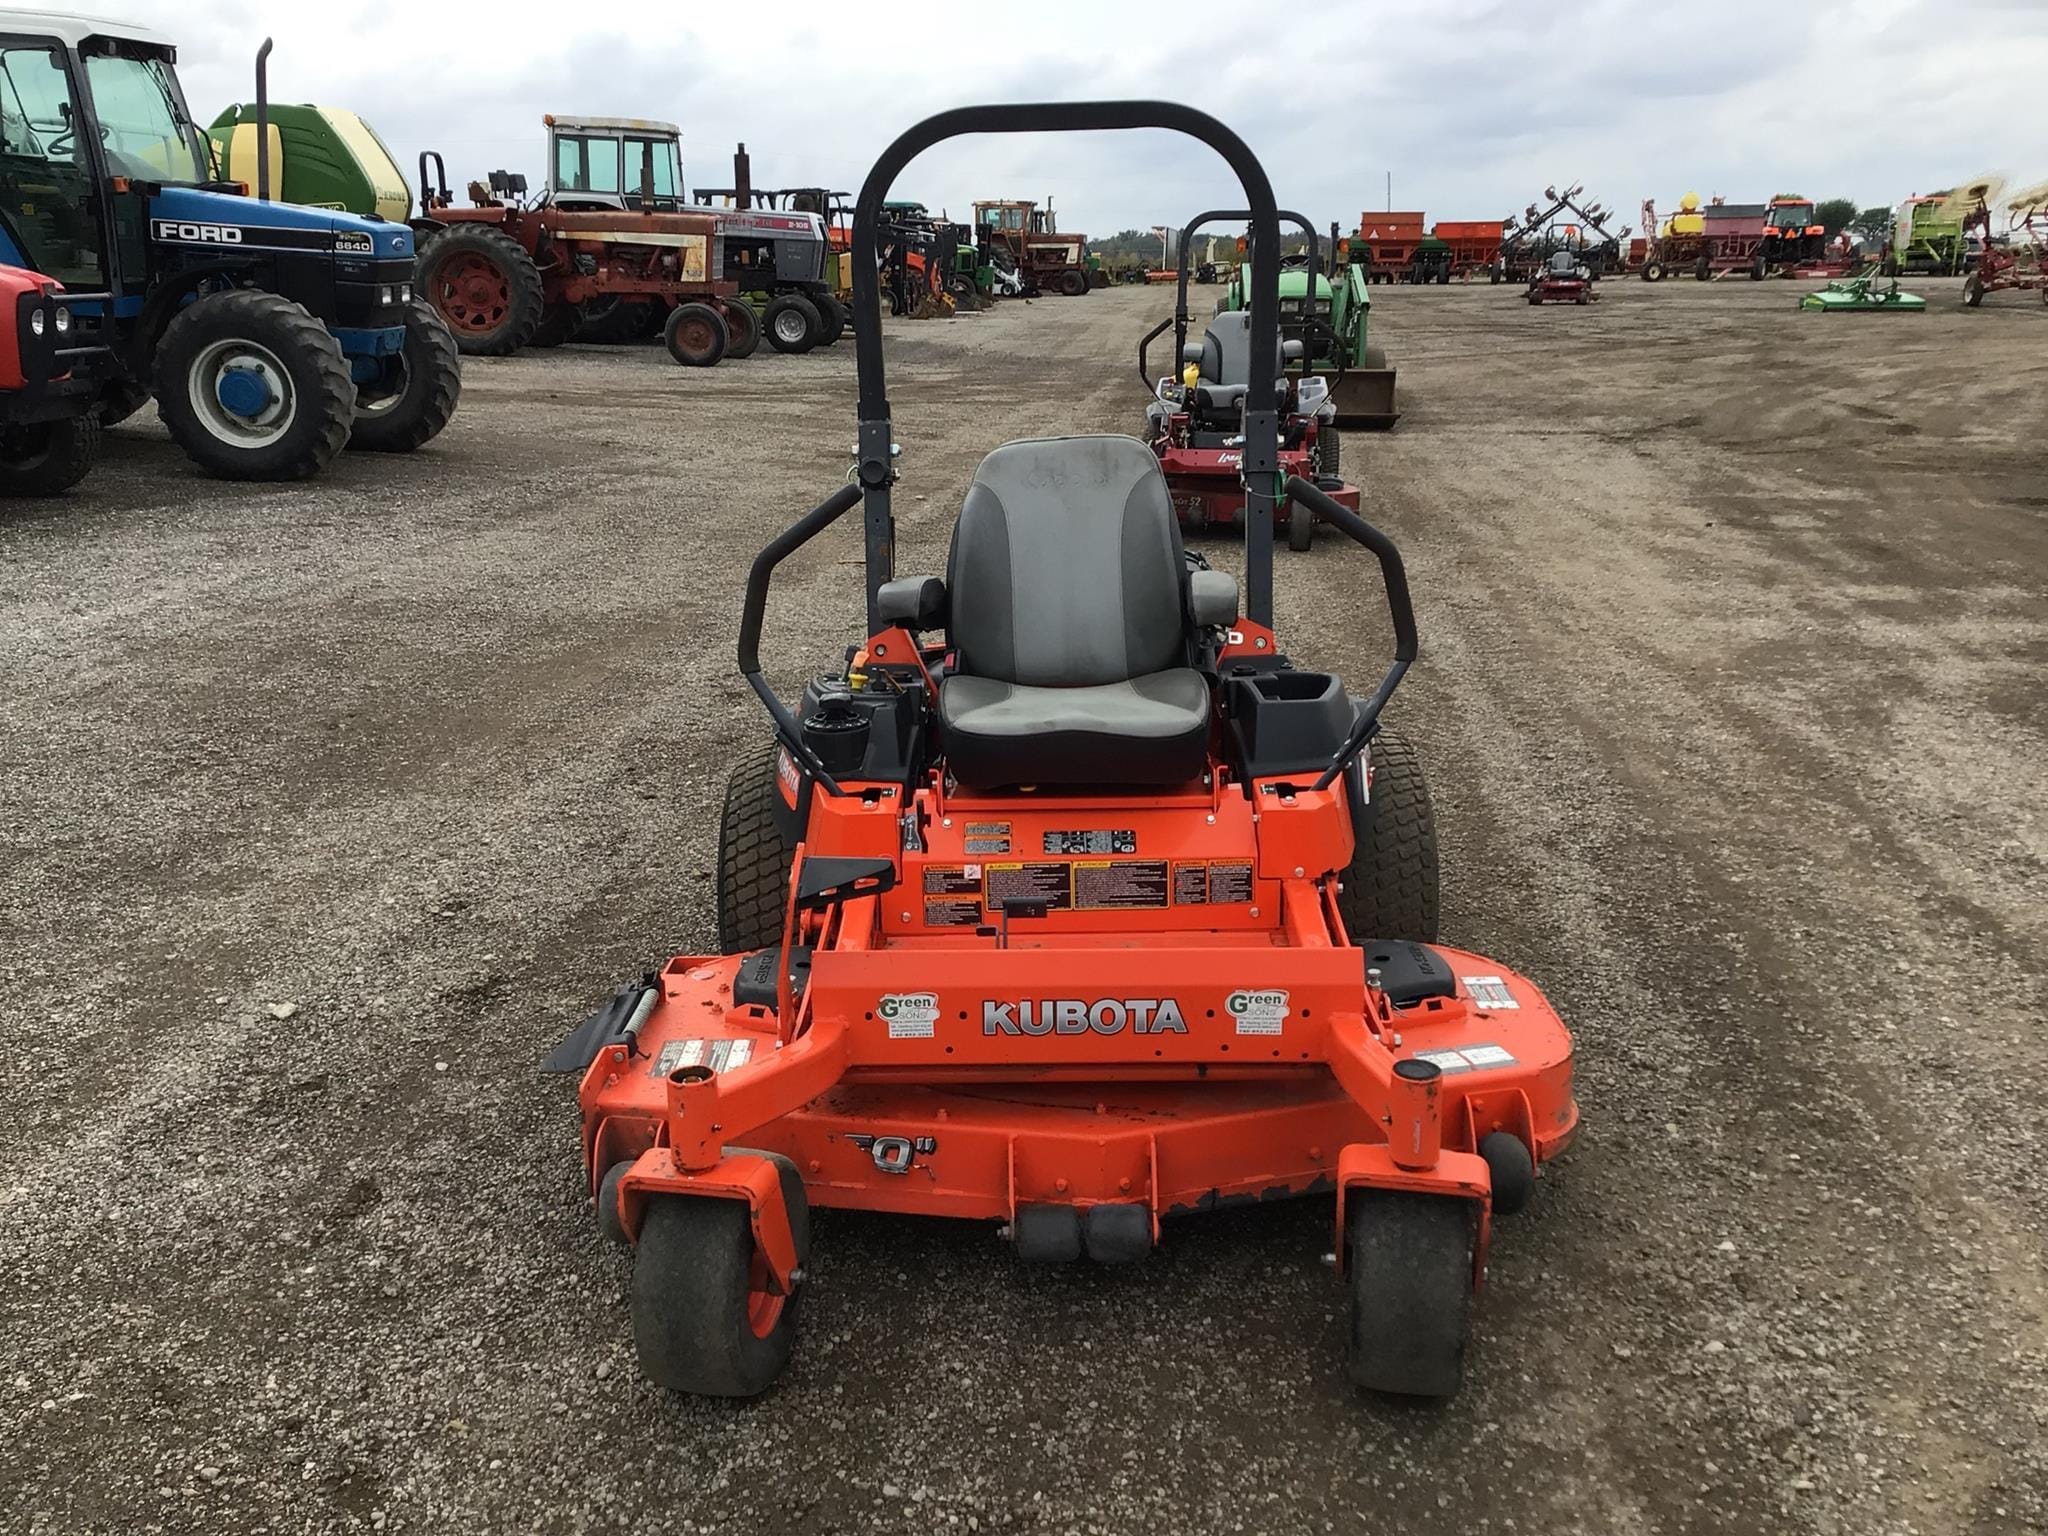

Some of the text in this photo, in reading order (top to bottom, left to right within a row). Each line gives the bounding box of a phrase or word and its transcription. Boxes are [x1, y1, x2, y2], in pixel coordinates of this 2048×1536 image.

[160, 222, 243, 244] FORD
[335, 241, 371, 251] 6640
[880, 998, 931, 1018] Green
[1229, 994, 1281, 1014] Green
[983, 999, 1189, 1036] KUBOTA
